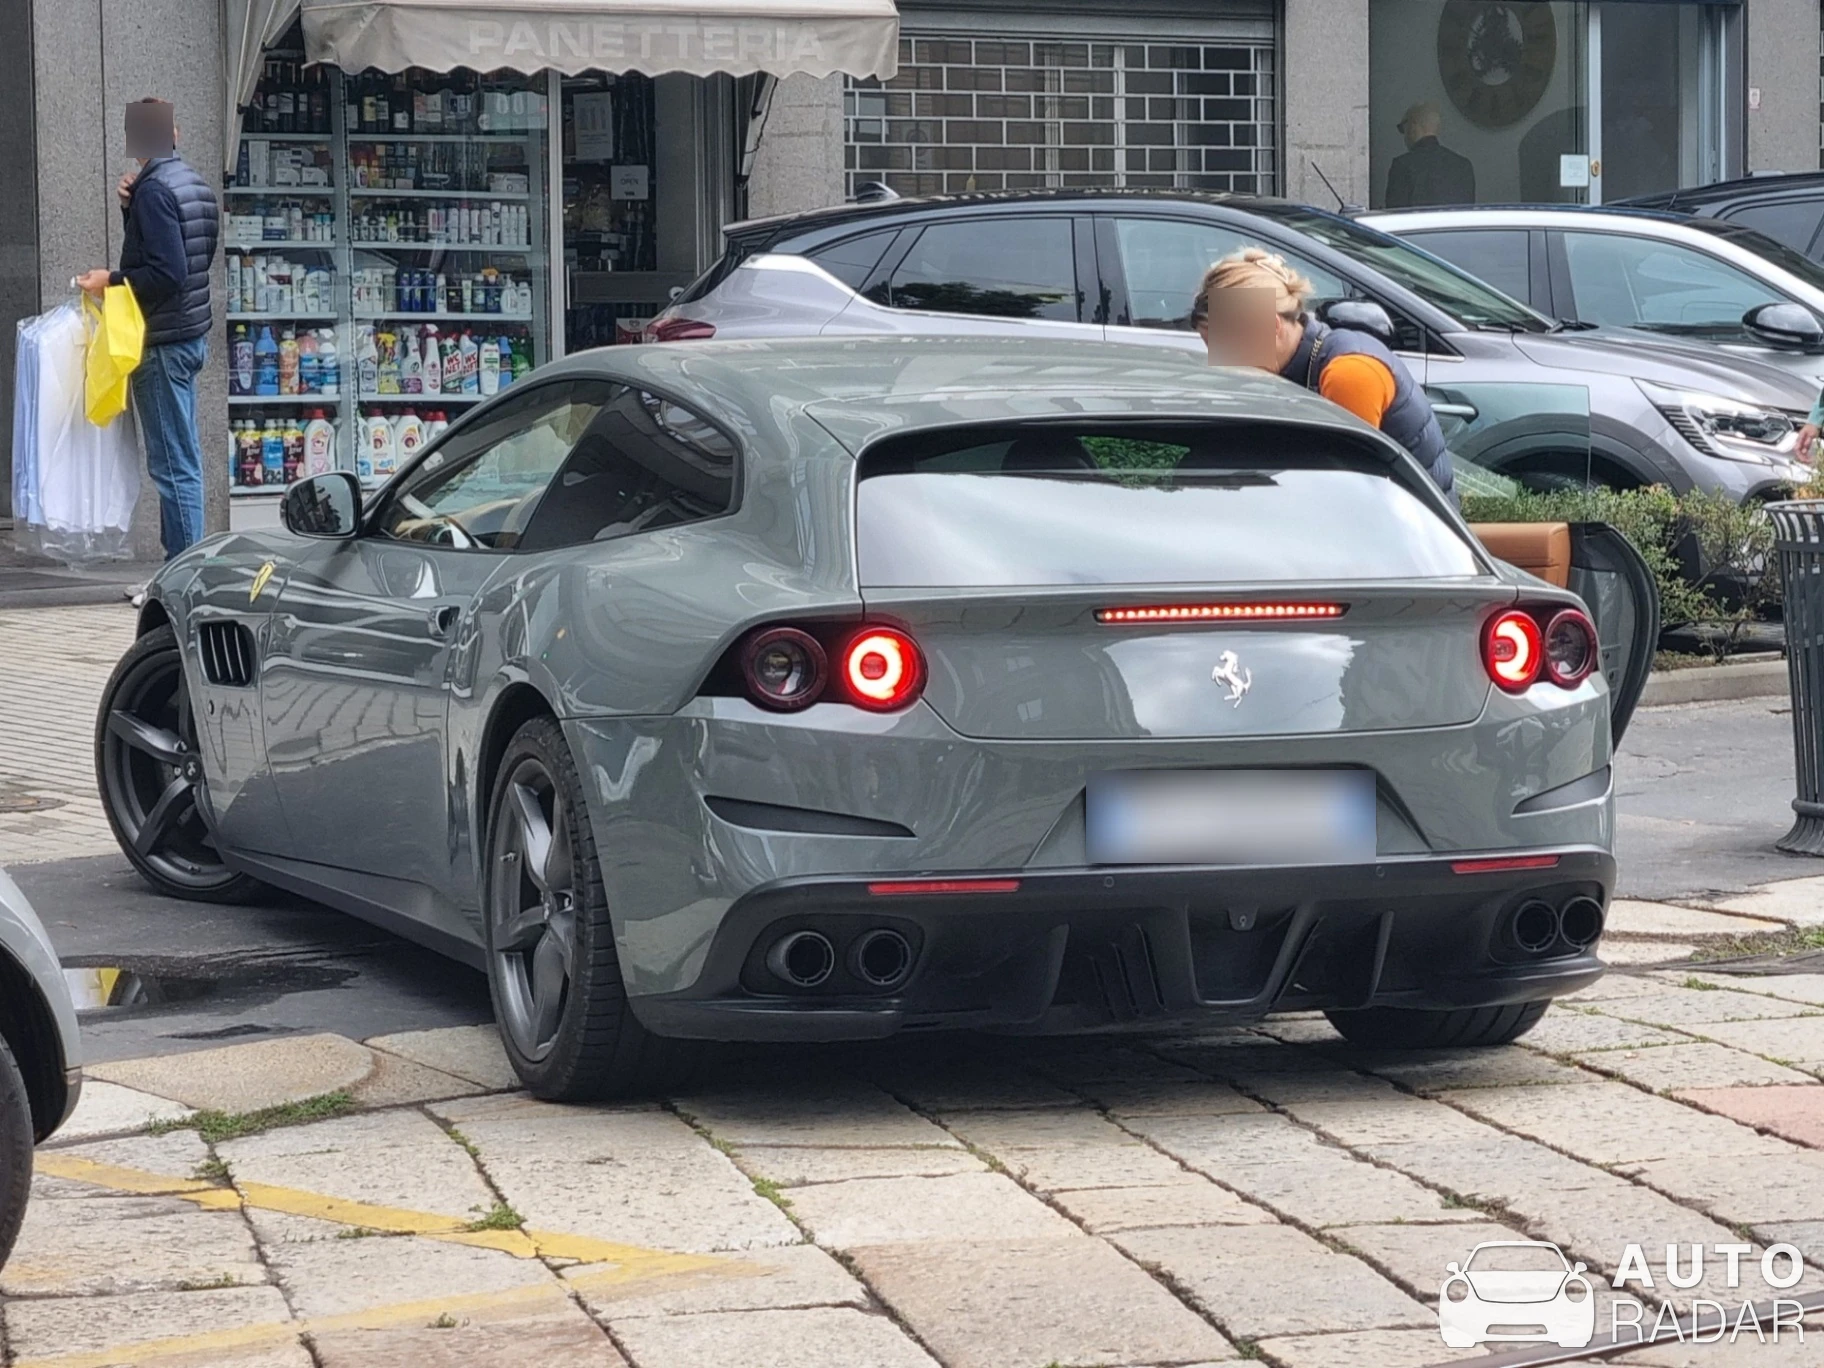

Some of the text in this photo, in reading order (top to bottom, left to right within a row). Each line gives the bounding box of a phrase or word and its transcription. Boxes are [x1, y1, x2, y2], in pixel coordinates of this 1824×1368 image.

[468, 20, 825, 62] PANETTERIA
[447, 353, 459, 365] WC
[465, 351, 477, 364] WC
[445, 361, 460, 375] NET
[463, 361, 477, 374] NET
